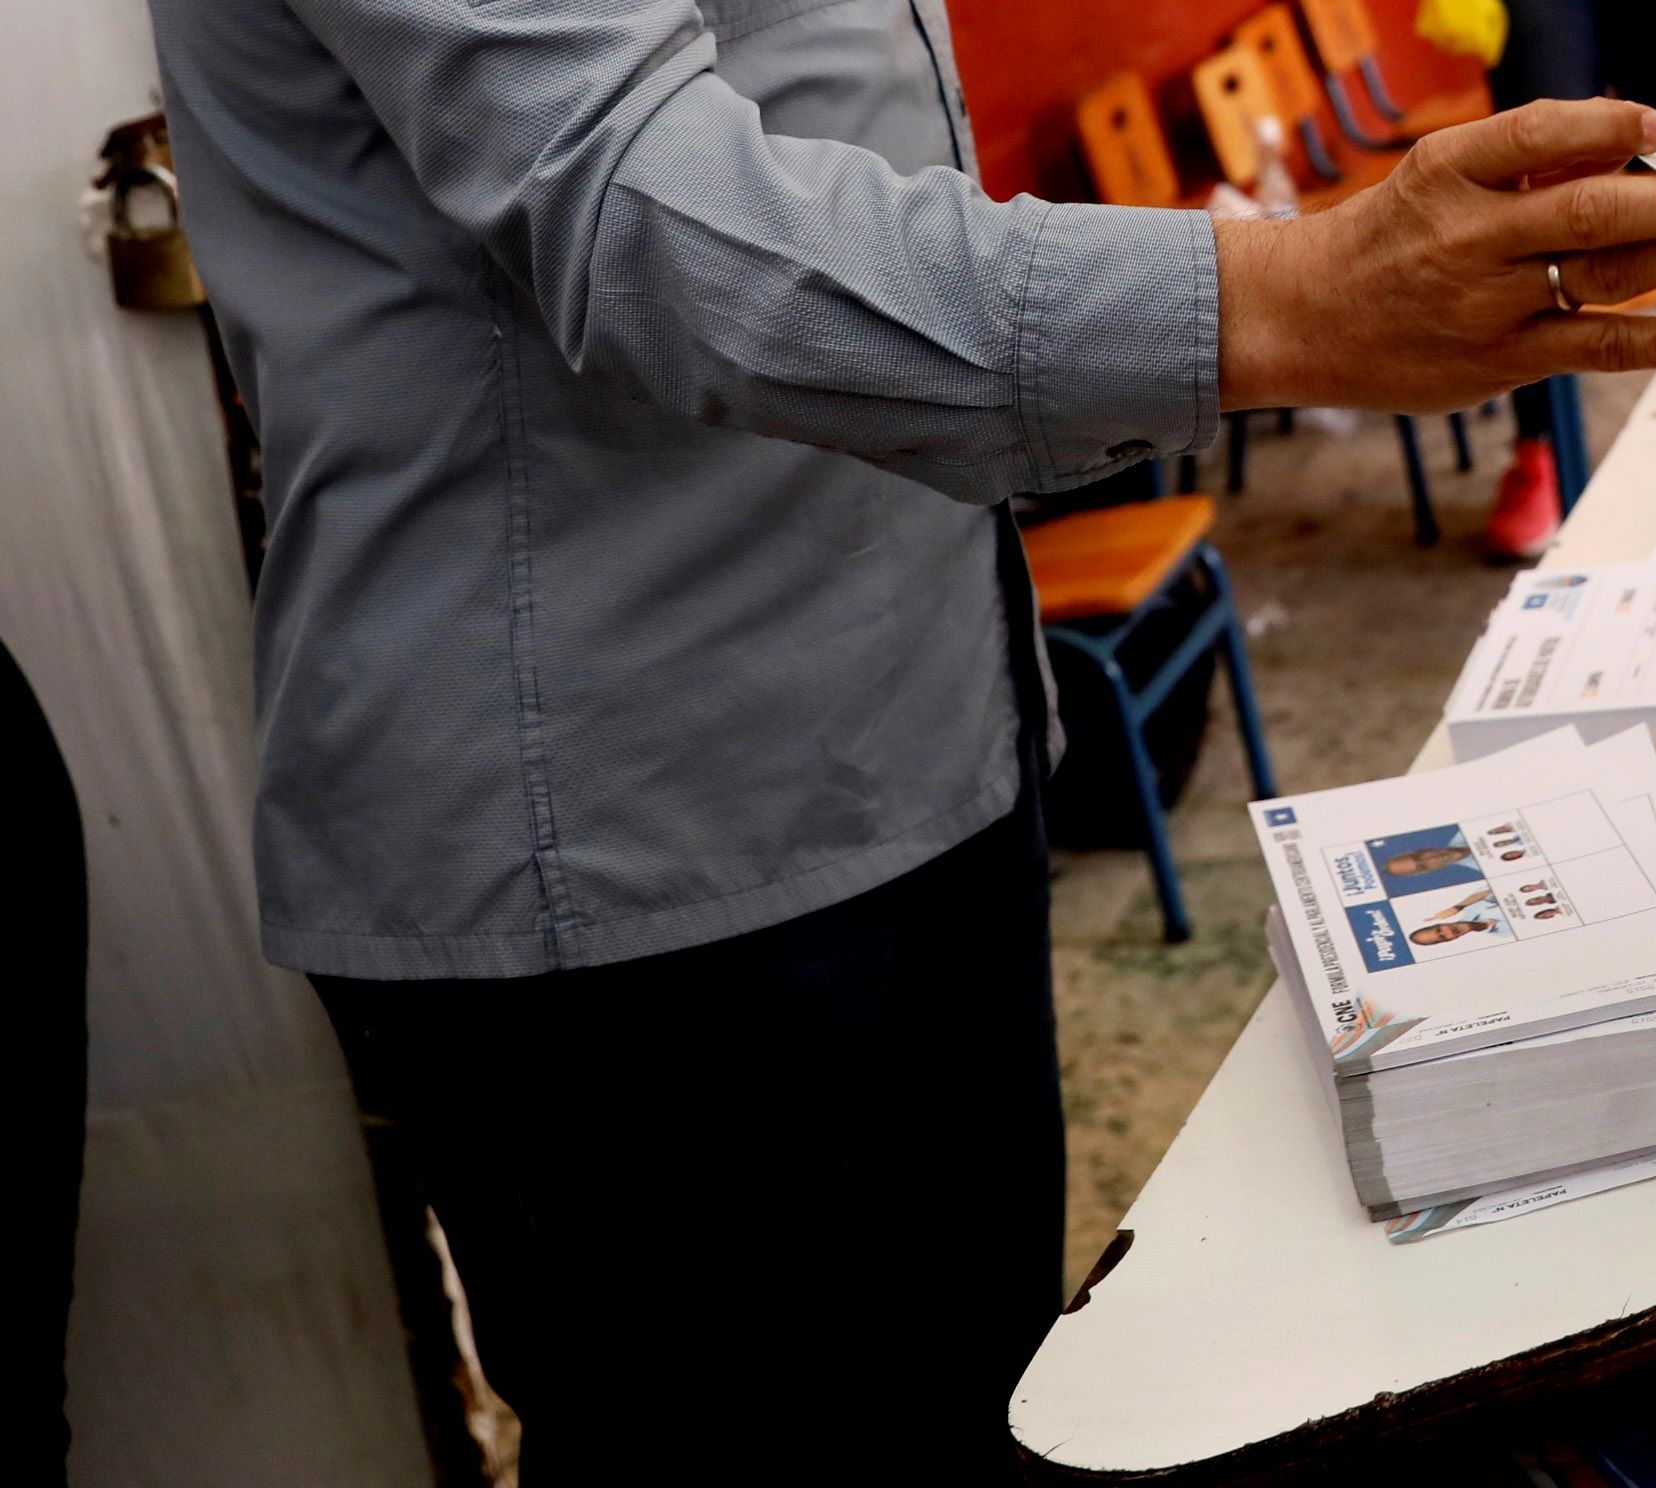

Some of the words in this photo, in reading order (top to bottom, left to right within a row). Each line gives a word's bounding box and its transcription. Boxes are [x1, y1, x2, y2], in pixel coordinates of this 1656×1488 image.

[1314, 928, 1339, 969] PRESIDENCIAL
[1332, 999, 1357, 1023] CNE
[1451, 1016, 1511, 1033] PAPELETA
[1508, 1188, 1567, 1209] PAPELETA
